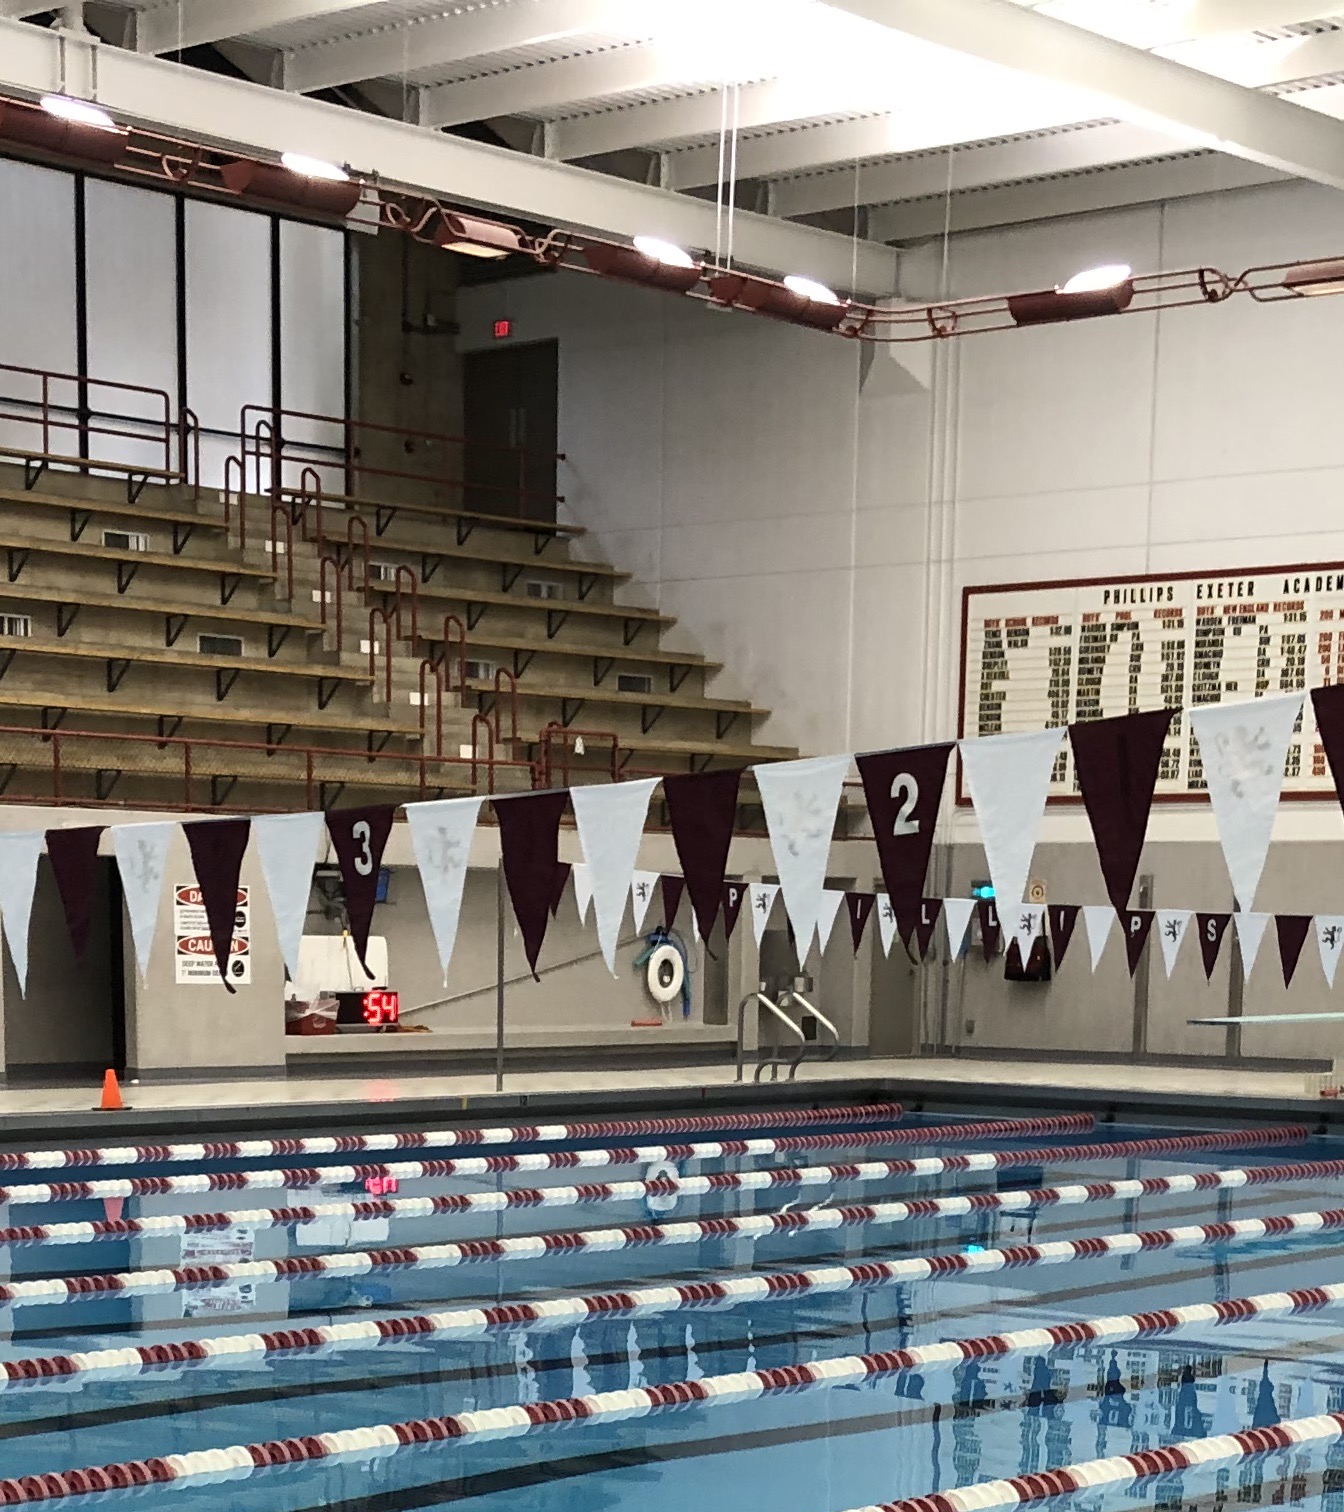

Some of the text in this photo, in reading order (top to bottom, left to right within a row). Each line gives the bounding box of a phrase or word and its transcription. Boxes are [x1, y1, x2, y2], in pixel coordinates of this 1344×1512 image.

[1103, 586, 1174, 605] PHILLIPS
[1197, 580, 1255, 600] EXETER
[1223, 605, 1237, 614] NEW
[890, 772, 920, 836] 2
[353, 821, 373, 876] 3
[729, 887, 738, 908] P
[921, 904, 931, 925] L
[1130, 916, 1142, 938] P
[1207, 918, 1218, 942] S
[188, 939, 239, 952] CAUN
